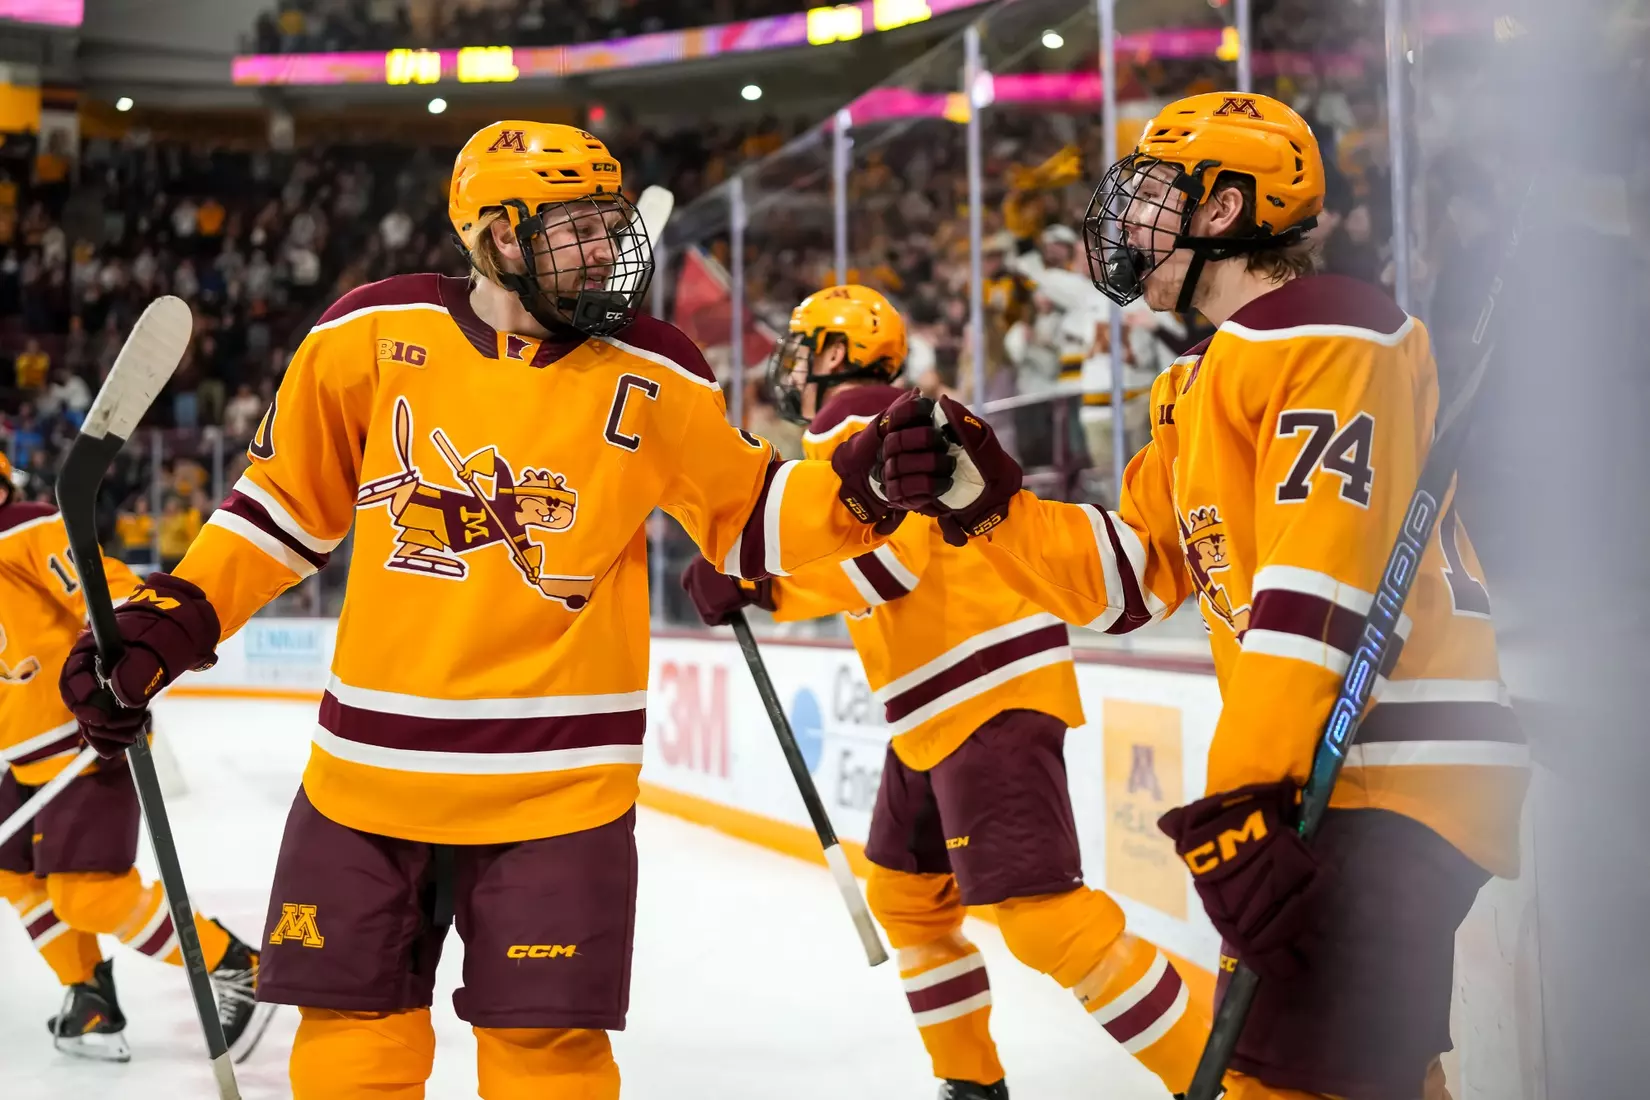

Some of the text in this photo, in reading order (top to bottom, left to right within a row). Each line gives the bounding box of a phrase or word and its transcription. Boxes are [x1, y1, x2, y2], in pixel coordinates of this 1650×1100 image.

[1213, 97, 1264, 120] M
[486, 130, 527, 153] M
[603, 372, 660, 452] C
[1275, 408, 1375, 510] 74
[846, 497, 868, 521] CCM
[974, 515, 1001, 536] CCM
[143, 667, 165, 696] CCM
[658, 660, 730, 780] 3M
[269, 903, 325, 948] M
[507, 944, 577, 959] CCM
